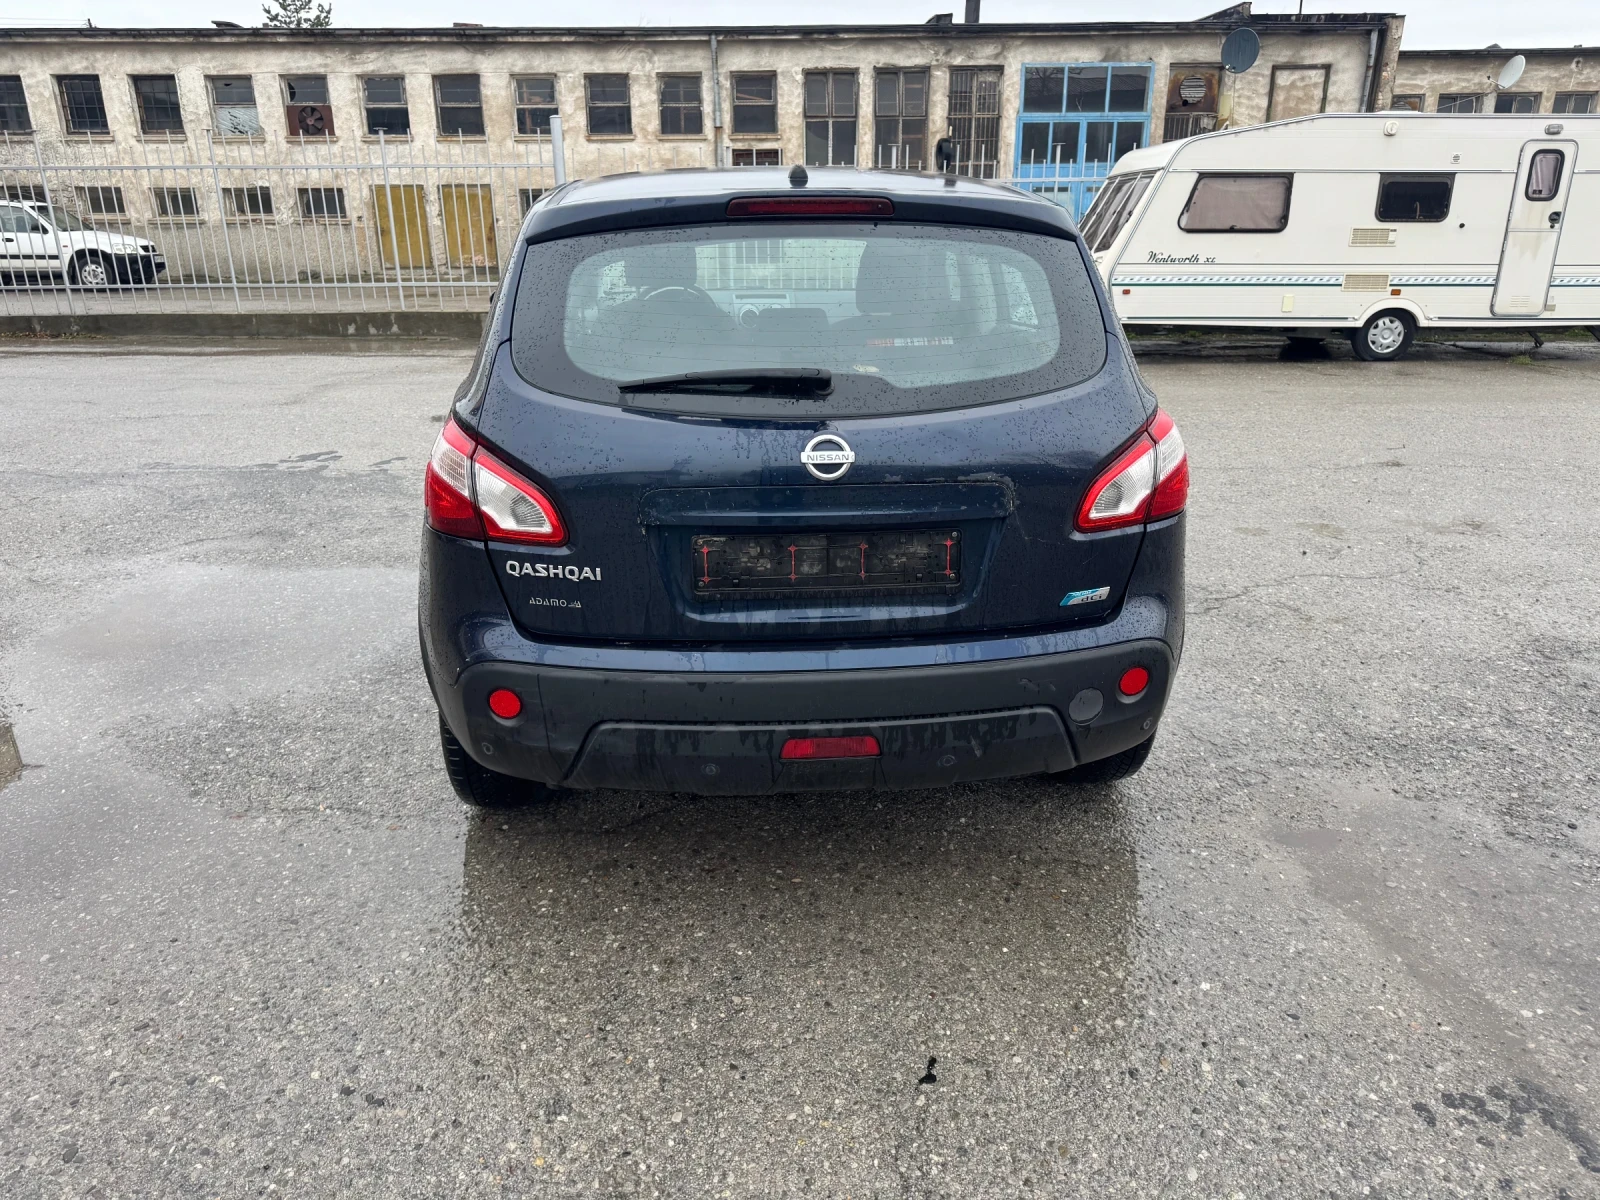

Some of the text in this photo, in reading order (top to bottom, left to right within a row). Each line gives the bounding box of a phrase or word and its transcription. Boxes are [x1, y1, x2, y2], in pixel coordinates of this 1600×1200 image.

[1147, 250, 1200, 263] Wentworth
[806, 454, 850, 462] NISSAN
[505, 560, 602, 582] QASHQAI
